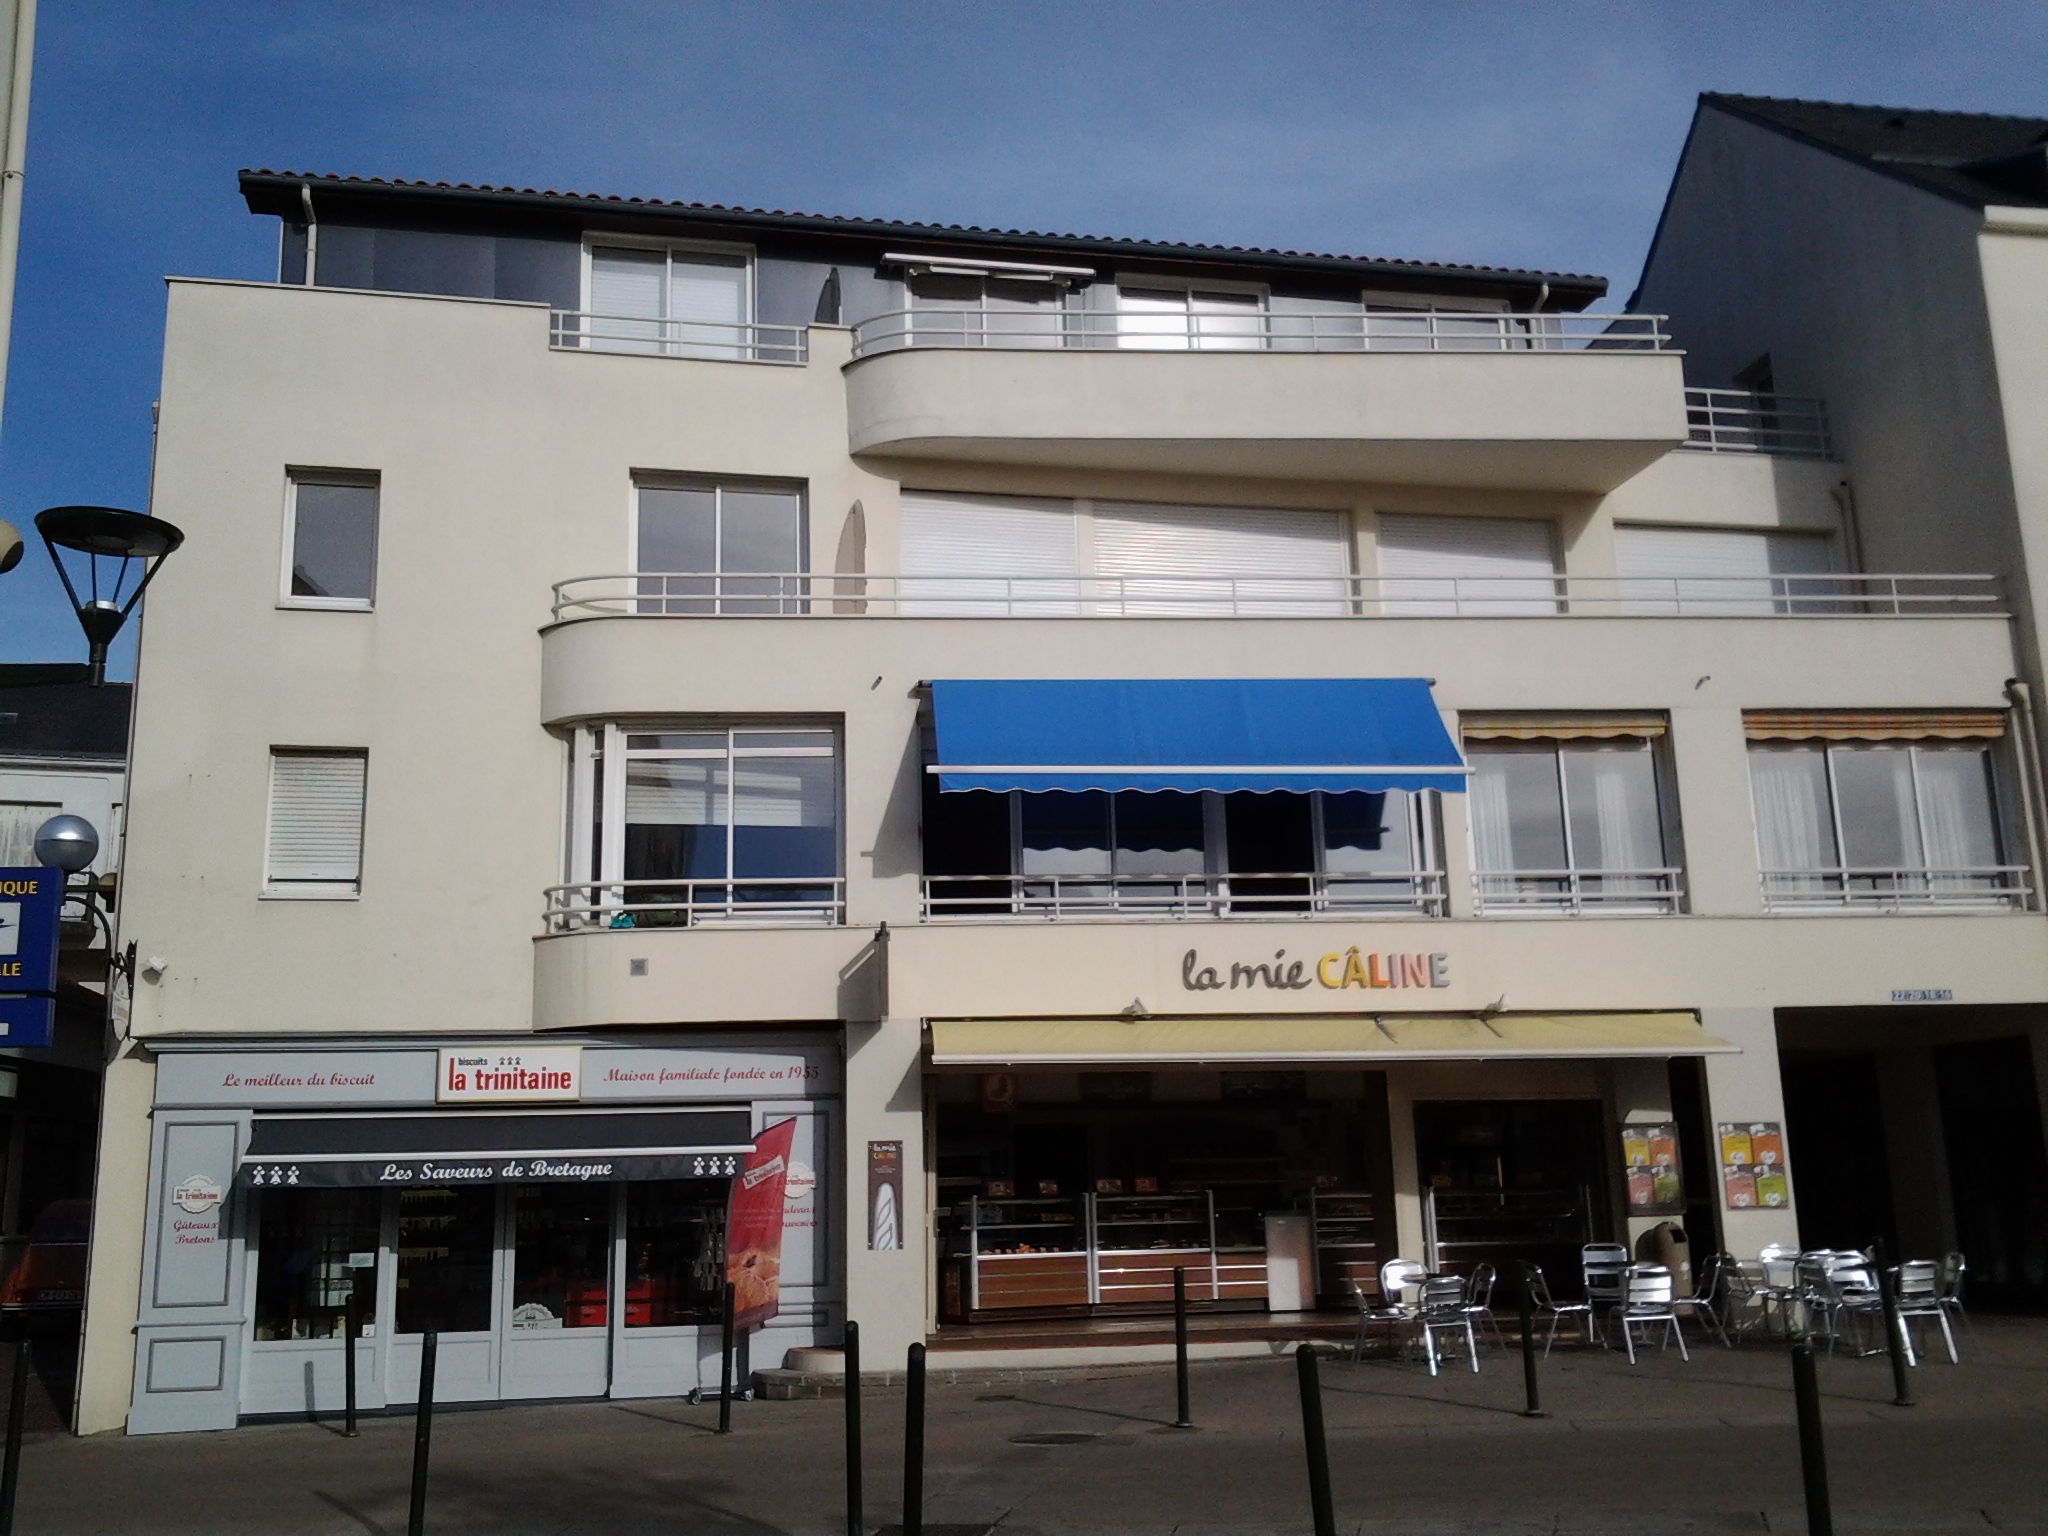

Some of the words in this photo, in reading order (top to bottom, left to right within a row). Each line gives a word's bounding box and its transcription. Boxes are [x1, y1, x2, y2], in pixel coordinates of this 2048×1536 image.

[0, 963, 21, 976] LE
[1182, 949, 1226, 991] la
[1230, 949, 1313, 990] mie
[1316, 945, 1451, 989] CÂLINE
[458, 1057, 488, 1066] biscuits
[222, 1073, 241, 1087] Le
[244, 1073, 302, 1087] meilleur
[307, 1072, 326, 1086] du
[330, 1072, 375, 1086] biscuit
[448, 1057, 467, 1091] la
[475, 1066, 572, 1090] trinitaine
[603, 1068, 655, 1082] Maison
[659, 1068, 720, 1084] familiale
[723, 1066, 765, 1084] fondée
[769, 1070, 783, 1079] en
[379, 1163, 413, 1181] Les
[419, 1162, 493, 1180] Saveurs
[502, 1161, 524, 1177] de
[528, 1160, 613, 1181] Bretagne
